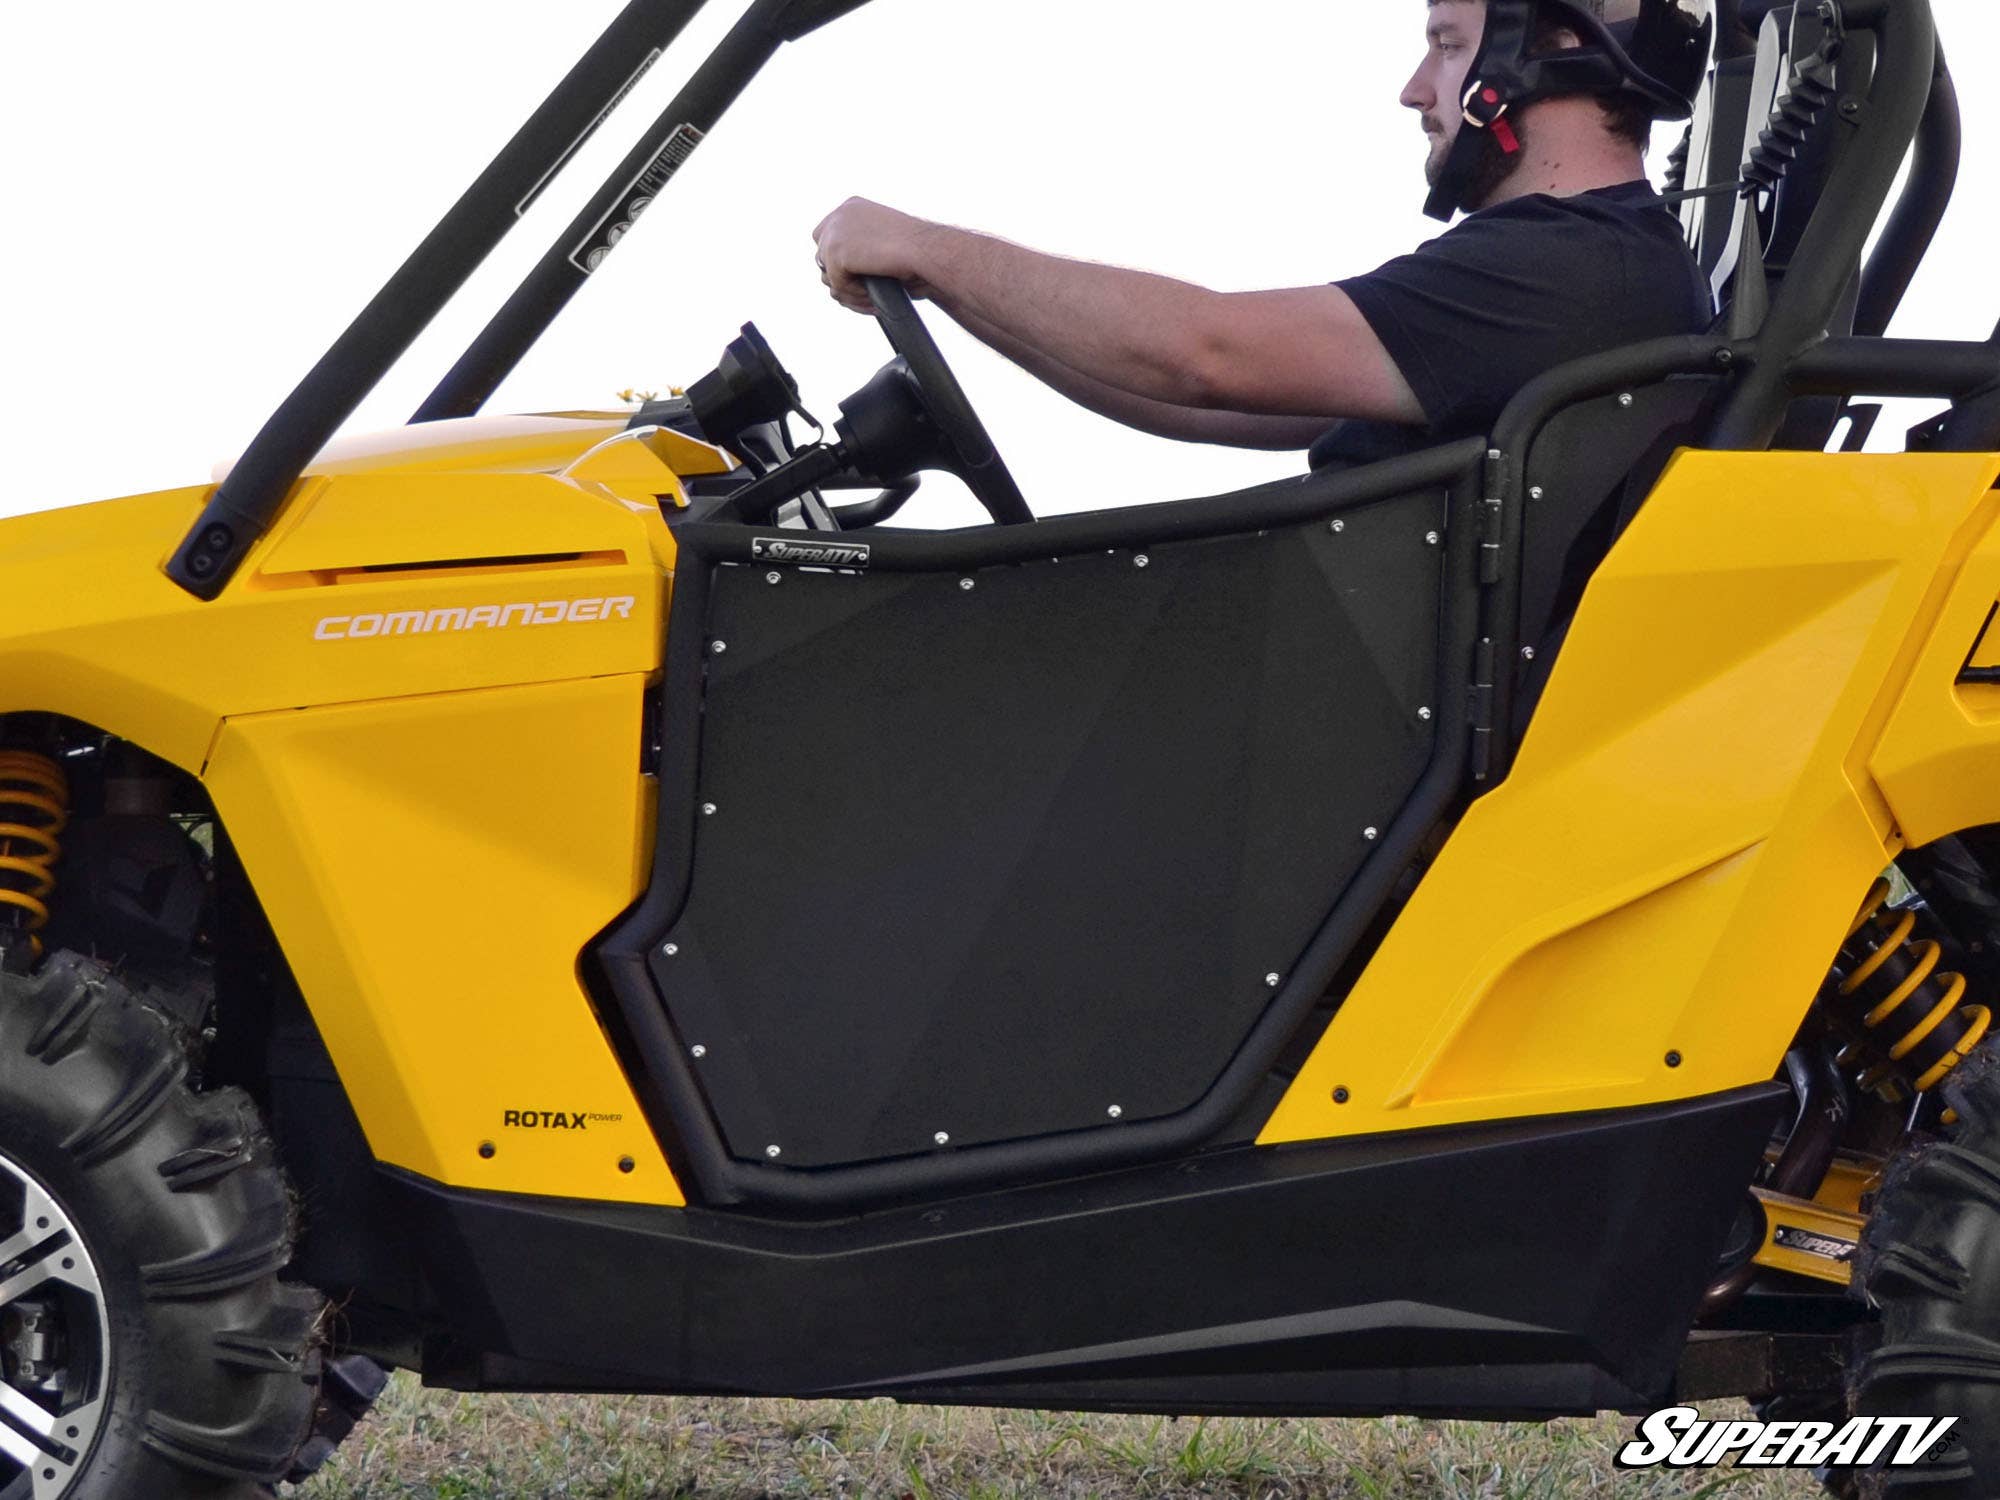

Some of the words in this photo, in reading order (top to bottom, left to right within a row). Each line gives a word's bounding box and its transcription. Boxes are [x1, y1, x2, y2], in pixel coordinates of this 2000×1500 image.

[764, 542, 860, 563] SUPERATV
[313, 596, 635, 640] COMMANDER
[504, 1110, 587, 1129] ROTAX
[588, 1113, 622, 1122] POWER
